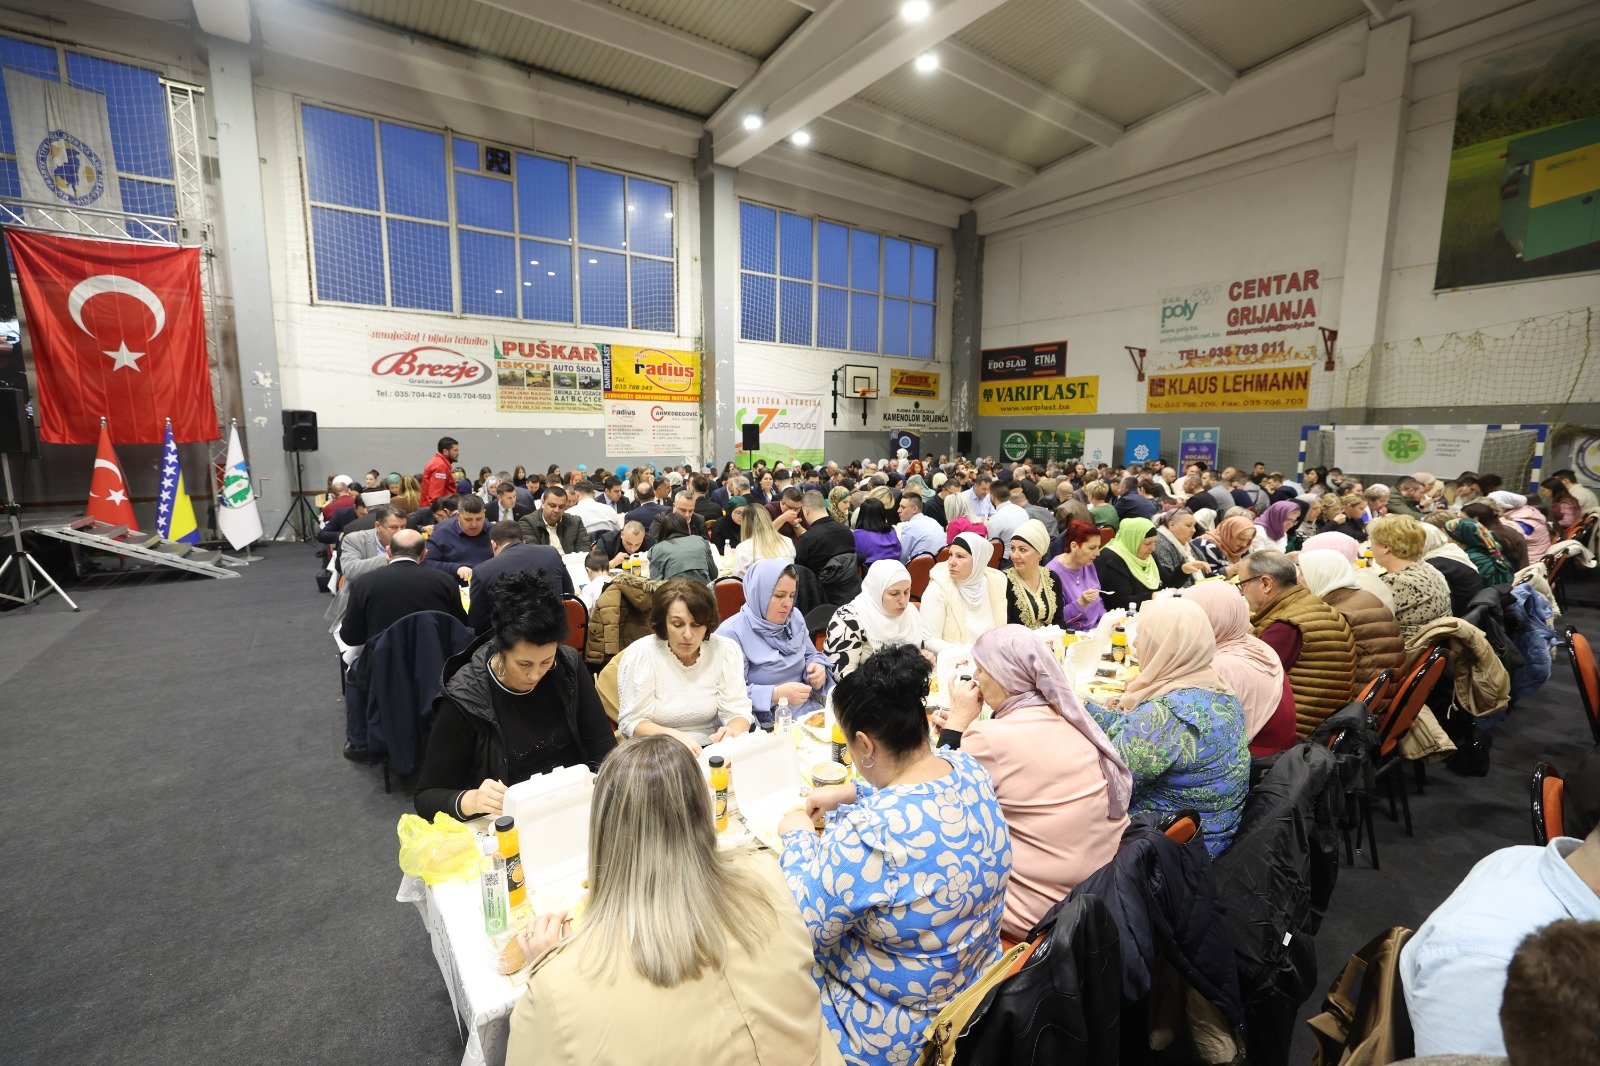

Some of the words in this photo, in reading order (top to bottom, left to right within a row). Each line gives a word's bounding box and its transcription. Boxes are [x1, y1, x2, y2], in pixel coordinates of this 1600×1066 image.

[1228, 269, 1320, 302] CENTAR
[1162, 299, 1199, 324] poly
[1227, 298, 1317, 327] GRIJANJA
[502, 340, 598, 362] PUŠKAR
[1034, 354, 1056, 365] ETNA
[1179, 348, 1206, 360] TEL:
[1262, 340, 1286, 354] 011
[372, 346, 479, 382] Brezje
[497, 361, 550, 370] ISKOPI
[576, 364, 601, 373] ŠKOLA
[634, 362, 694, 377] radius
[988, 360, 1004, 370] EDO
[1006, 359, 1026, 368] SLAD
[996, 382, 1090, 402] VARIPLAST
[1168, 376, 1218, 396] KLAUS
[1222, 370, 1309, 394] LEHMANN
[883, 413, 920, 422] KAMENOLOM
[1000, 404, 1070, 412] www.variplast.ba
